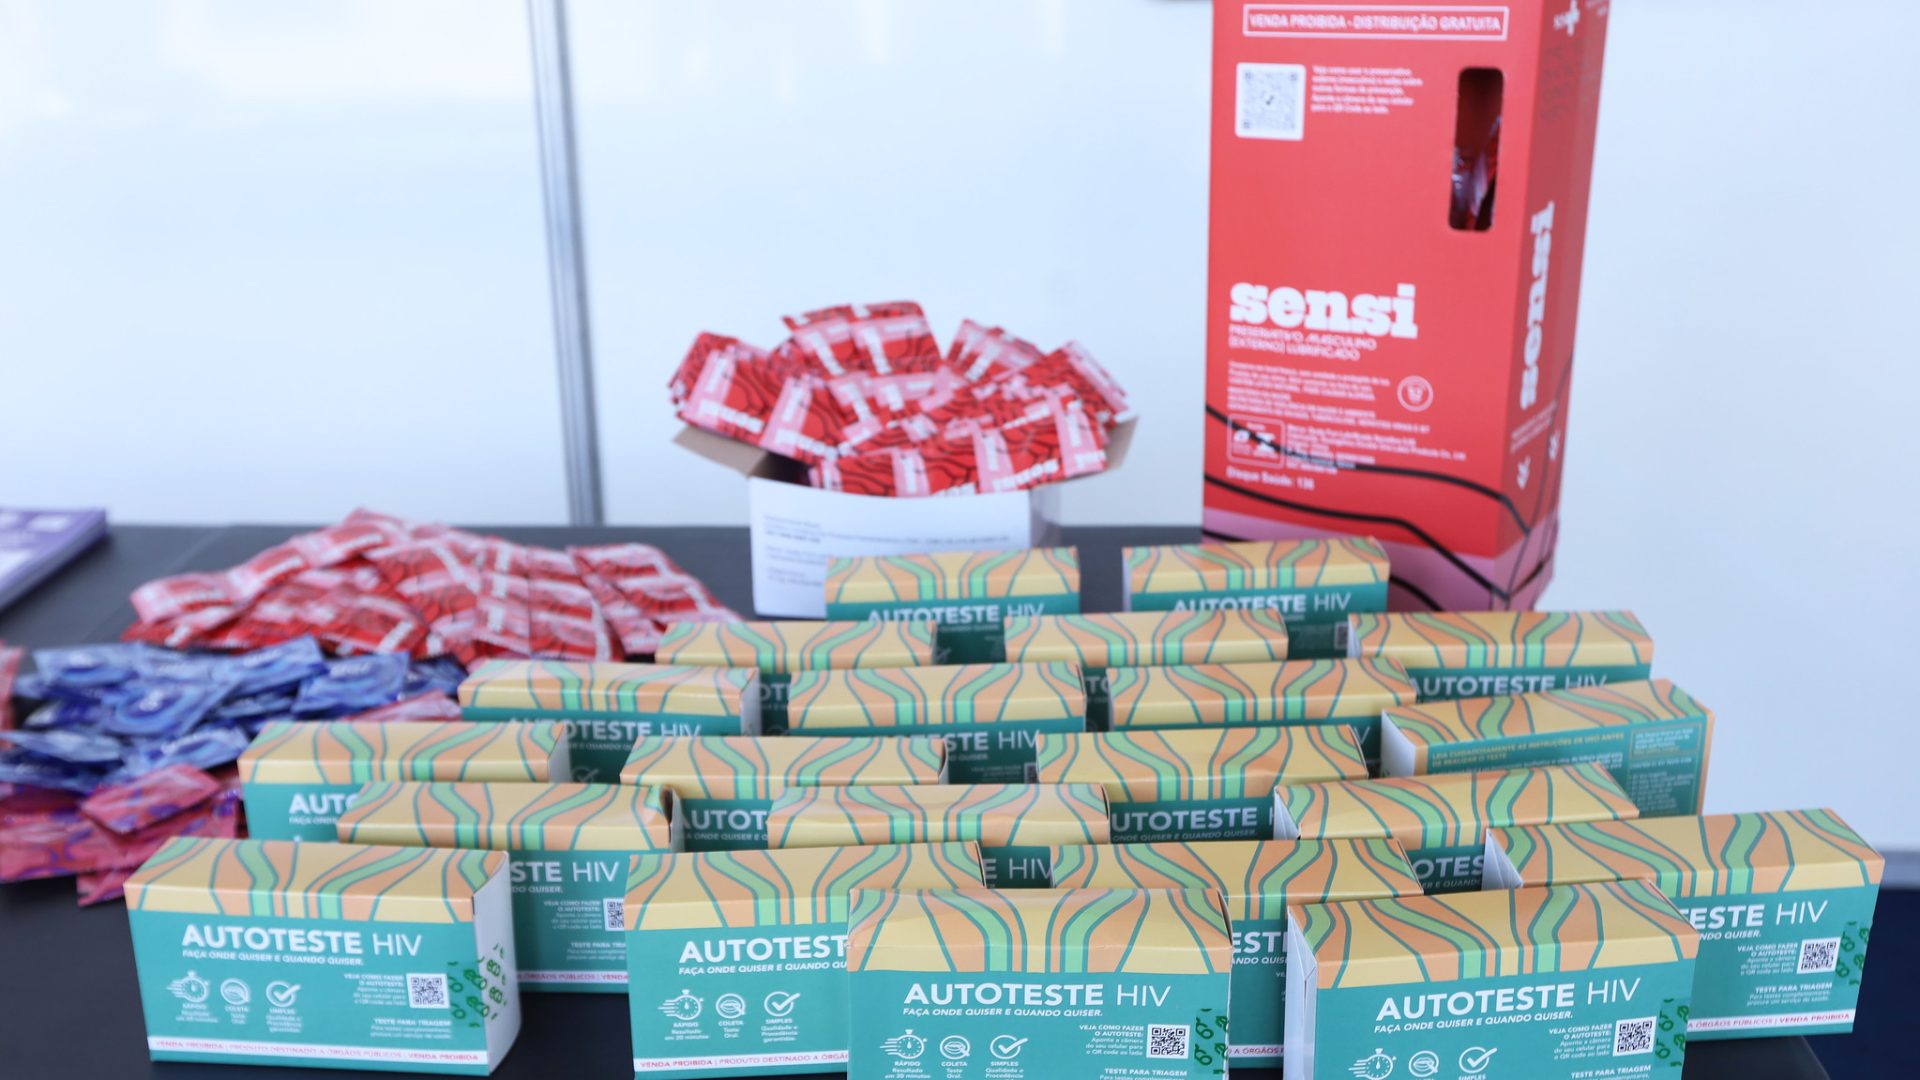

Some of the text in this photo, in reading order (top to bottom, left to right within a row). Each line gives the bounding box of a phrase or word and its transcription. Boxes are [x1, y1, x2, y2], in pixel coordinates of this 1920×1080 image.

[1249, 13, 1288, 28] VENDA
[1290, 14, 1346, 29] PROIBIDA
[1439, 16, 1501, 31] GRATUITA
[1230, 282, 1418, 339] sensi
[1519, 201, 1555, 411] sensi
[1313, 592, 1352, 611] HIV
[998, 729, 1041, 750] HIV
[1111, 806, 1258, 832] UTOTESTE
[572, 861, 619, 882] HIV
[1775, 900, 1829, 925] HIV
[181, 924, 423, 957] AUTOTESTE HIV
[1724, 929, 1762, 939] QUISER.
[209, 951, 238, 960] ONDE
[239, 952, 273, 963] QUISER
[283, 954, 326, 965] QUANDO
[679, 935, 849, 964] AUTOTEST
[678, 962, 830, 977] FAÇA ONDE QUISER E QUANDO
[903, 982, 1172, 1007] AUTOTESTE HIV
[1376, 976, 1641, 1022] AUTOTESTE HIV
[903, 1007, 1103, 1017] FAÇA ONDE QUISER E QUANDO QUISER.
[1374, 1024, 1401, 1034] FAÇA
[1403, 1022, 1433, 1031] ONDE
[1436, 1020, 1473, 1029] QUISER
[1485, 1014, 1532, 1025] QUANDO
[1534, 1011, 1573, 1021] QUISER.
[719, 1057, 761, 1065] PRODUTO
[762, 1054, 811, 1064] DESTINADO
[1128, 1068, 1150, 1076] PARA
[1571, 1064, 1651, 1079] TESTE PARA TRIAGEM
